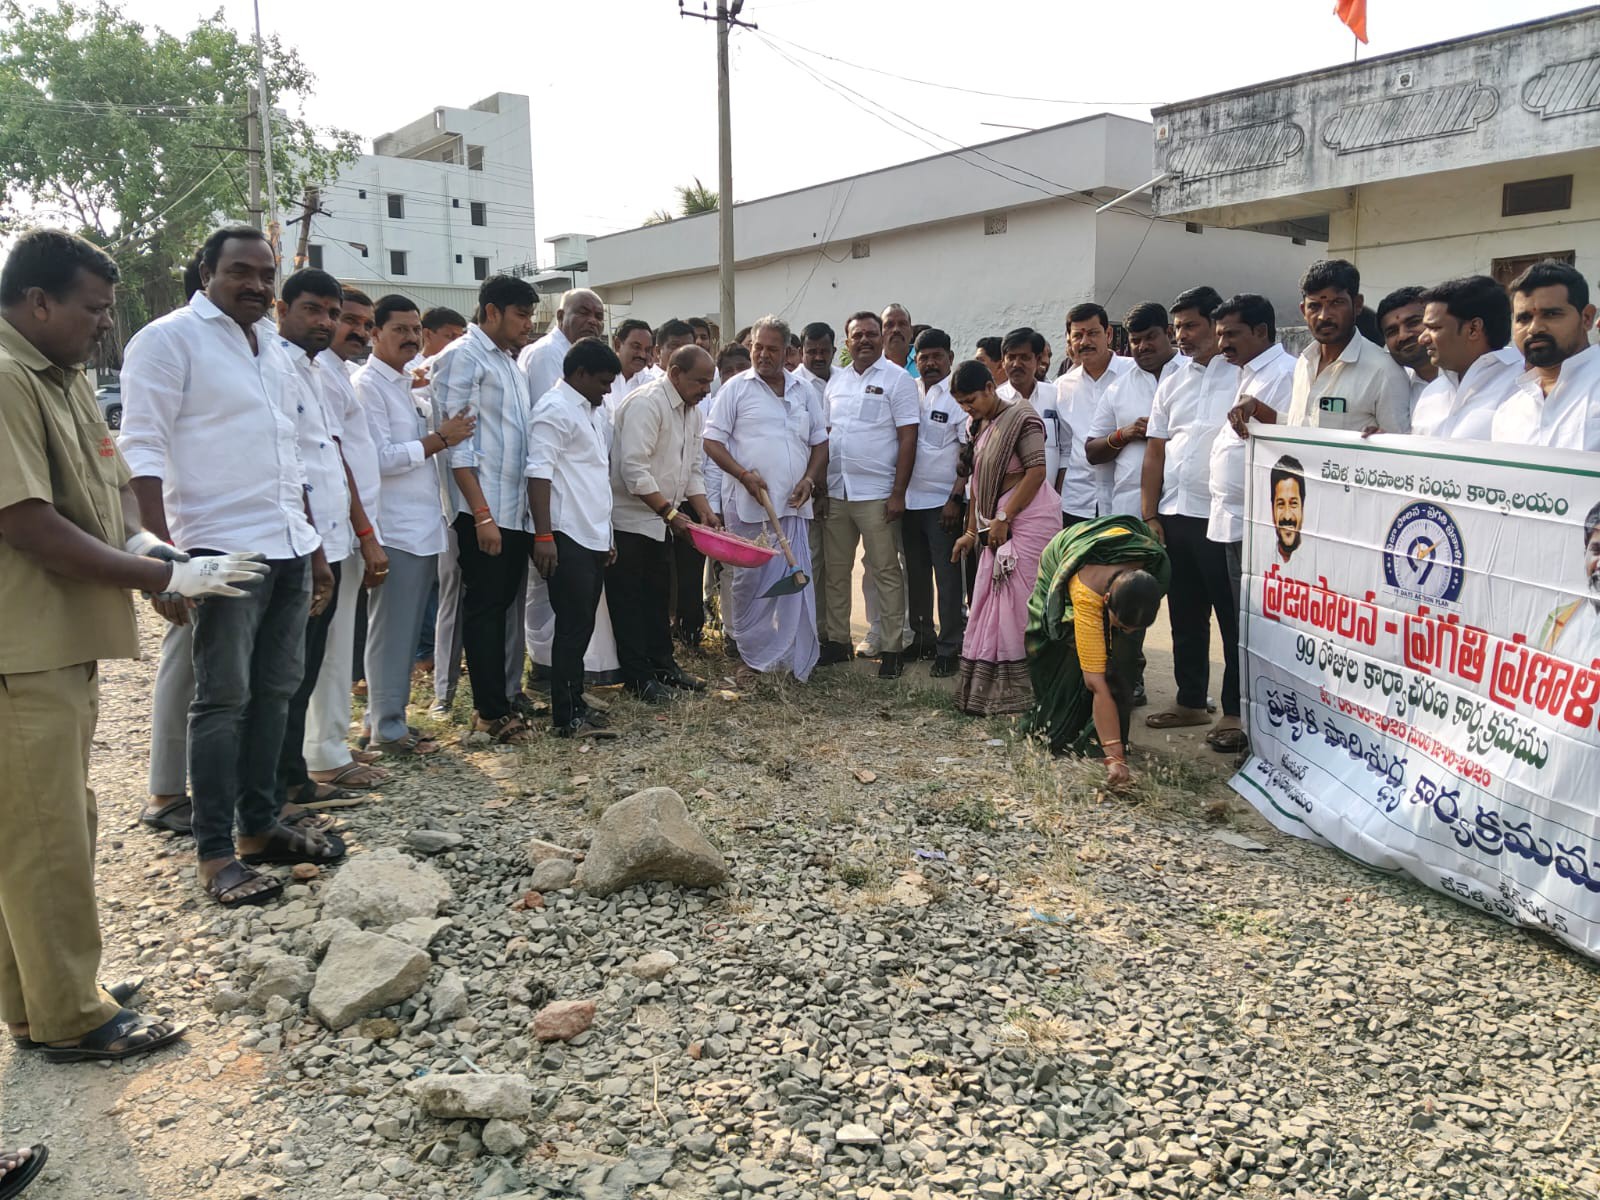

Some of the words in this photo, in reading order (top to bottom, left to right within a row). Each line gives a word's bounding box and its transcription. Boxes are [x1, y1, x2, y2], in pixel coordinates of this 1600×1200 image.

[1354, 467, 1415, 492] పురపాలక
[1419, 477, 1462, 501] సంఘ
[1466, 485, 1569, 516] కార్యాలయం
[1263, 563, 1378, 646] ప్రజాపాలన
[1404, 605, 1489, 684] ప్రగతి
[1435, 598, 1449, 607] PLAN
[1295, 634, 1316, 665] 99
[1319, 638, 1359, 683] రోజుల
[1363, 661, 1449, 719] కార్యాచరణ
[1453, 695, 1549, 770] కార్యక్రమము
